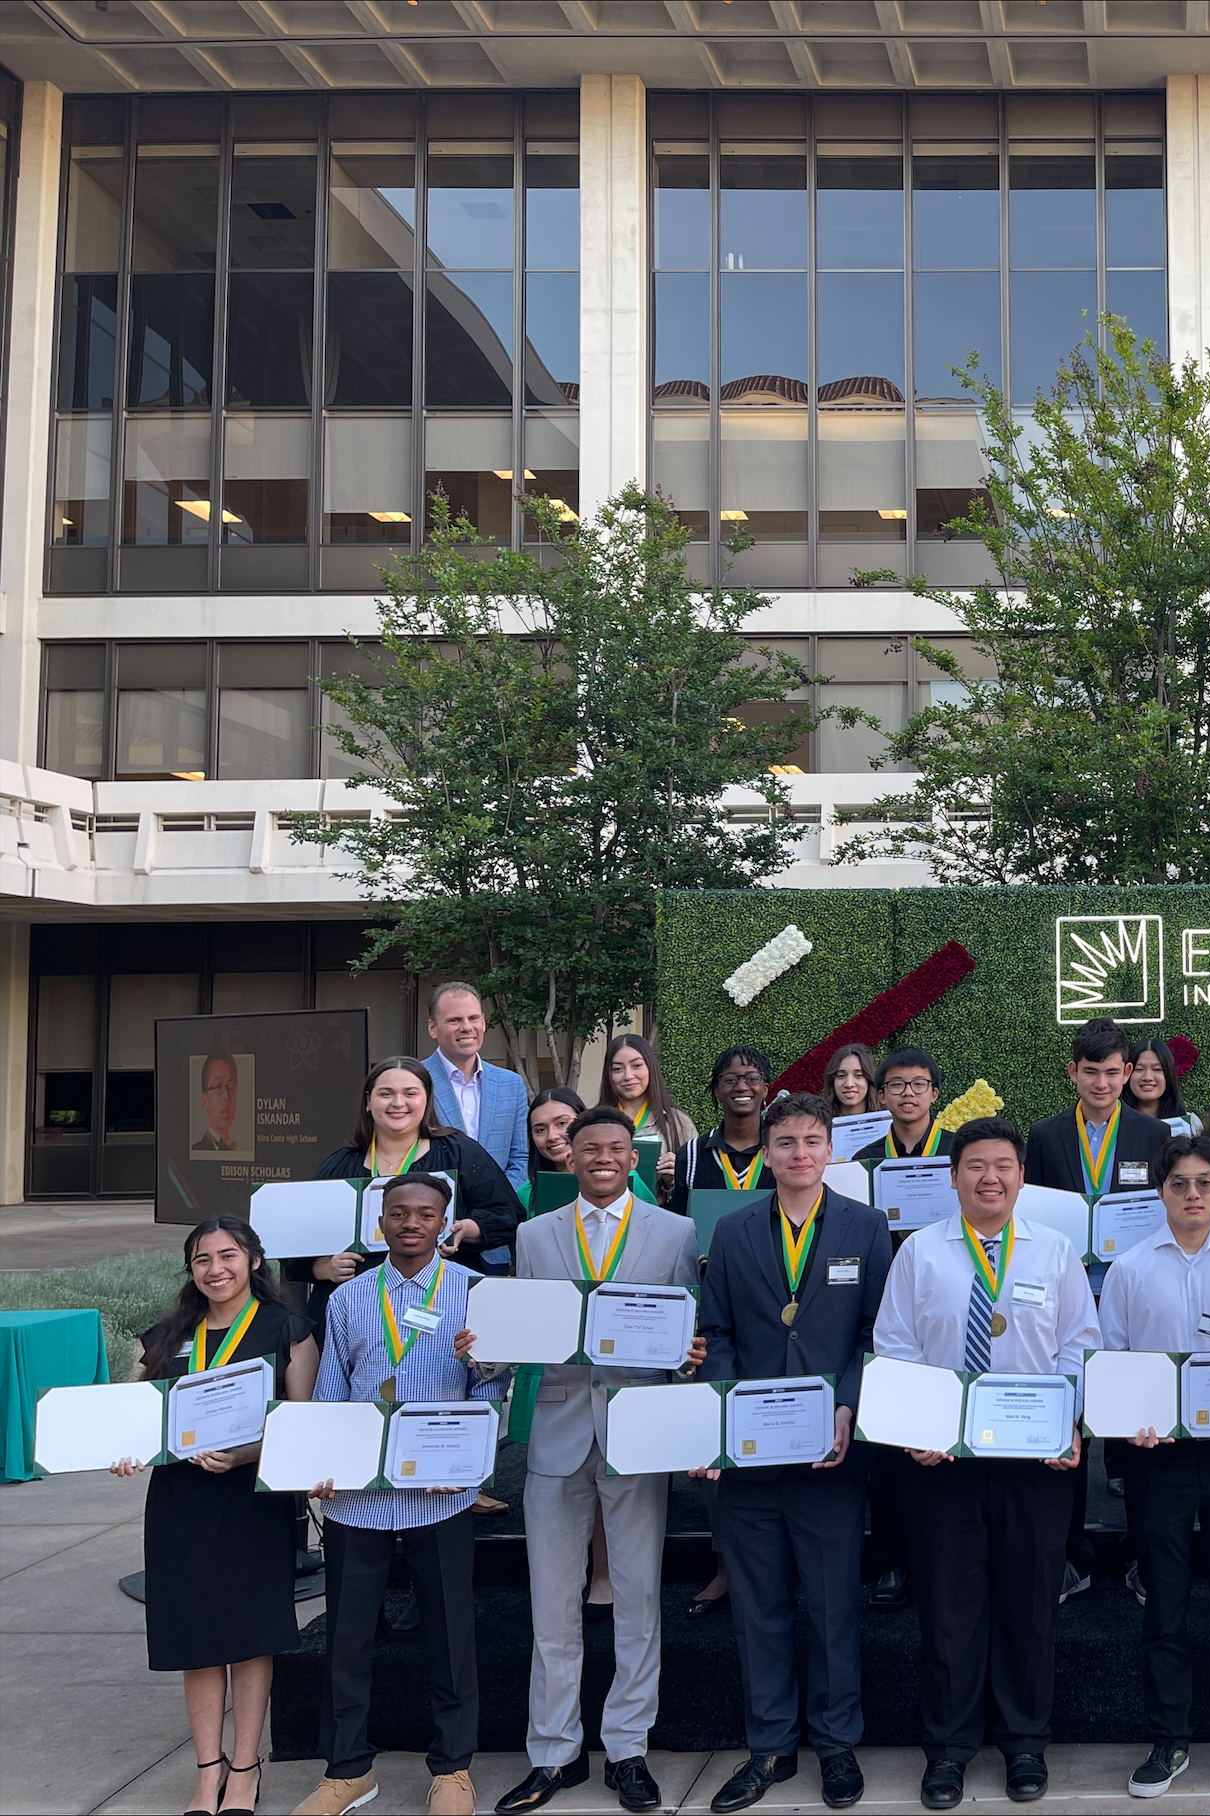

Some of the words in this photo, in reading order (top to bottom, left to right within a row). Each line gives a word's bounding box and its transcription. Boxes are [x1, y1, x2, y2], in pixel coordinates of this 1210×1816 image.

[257, 1098, 286, 1110] DYLAN
[257, 1113, 301, 1125] ISKANDAR
[286, 1134, 298, 1145] High
[299, 1134, 318, 1142] School
[221, 1165, 249, 1177] EDISON
[250, 1166, 291, 1178] SCHOLARS
